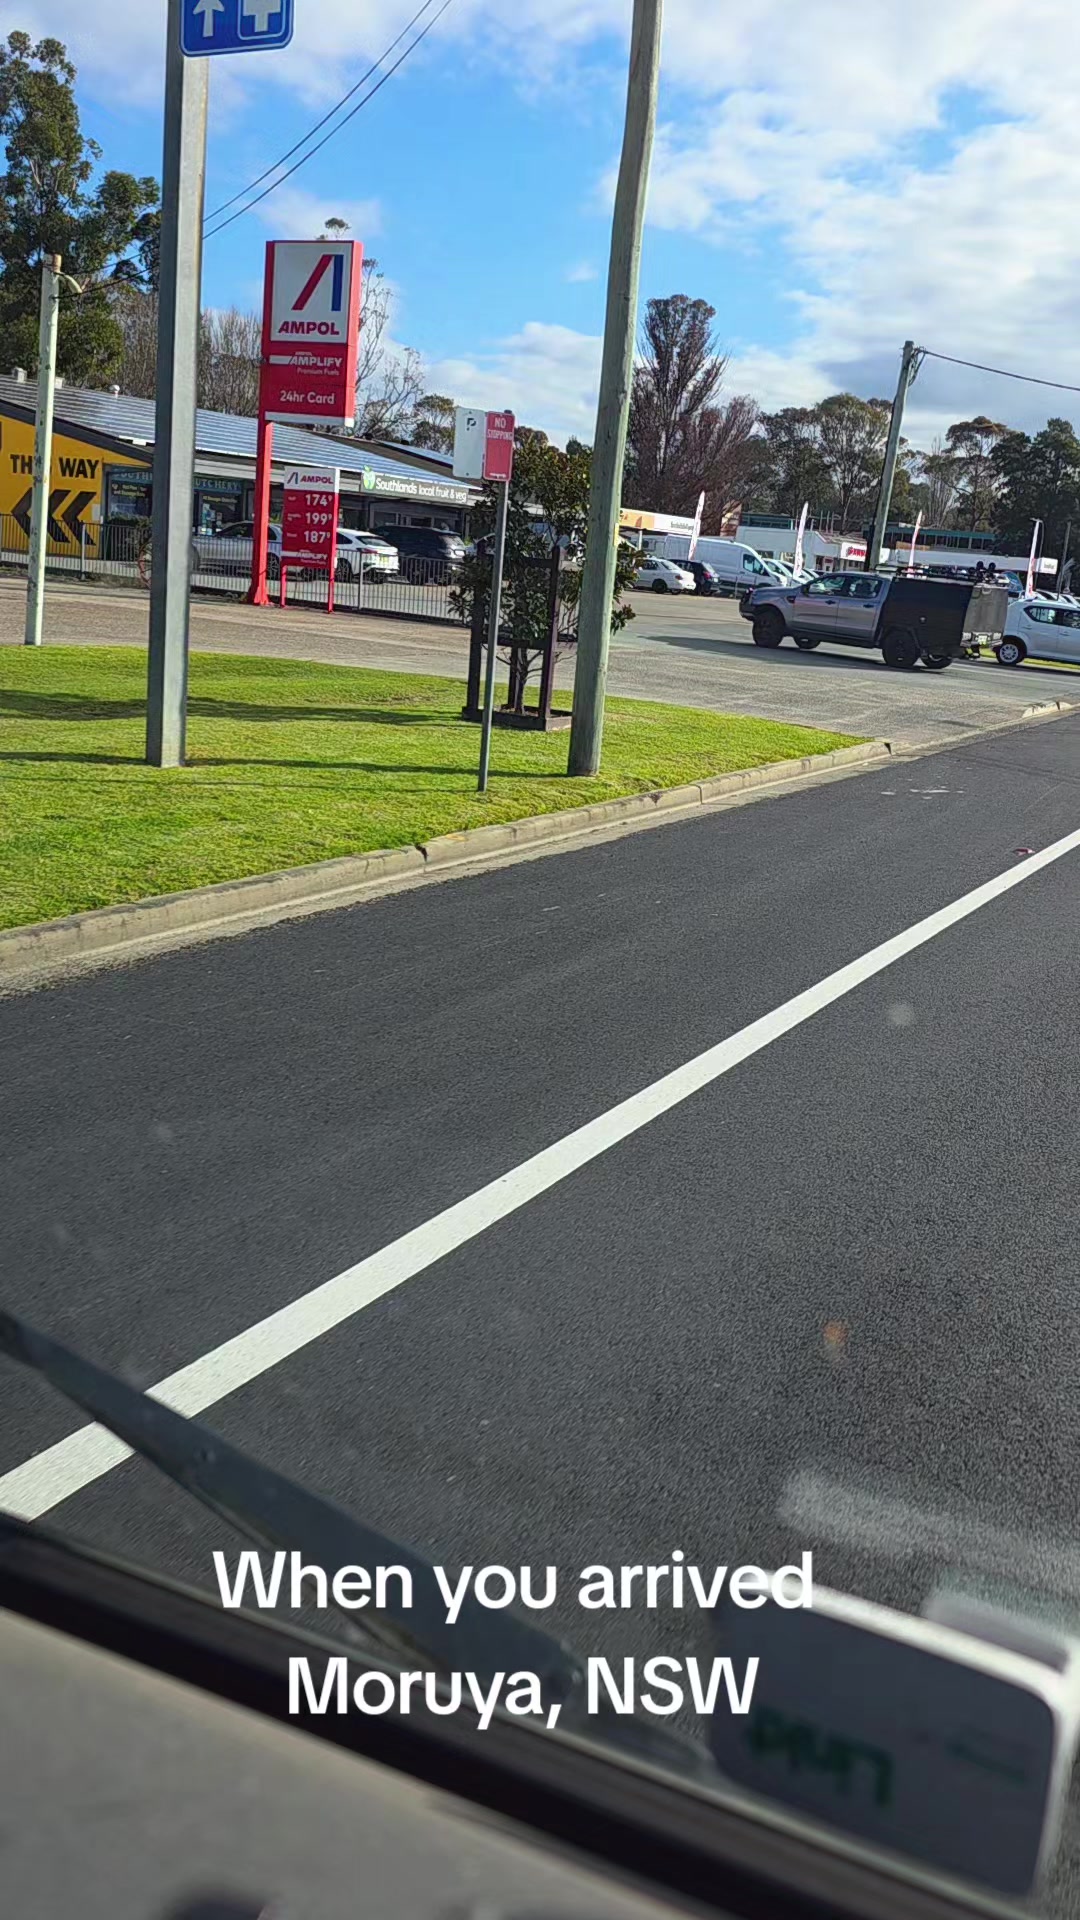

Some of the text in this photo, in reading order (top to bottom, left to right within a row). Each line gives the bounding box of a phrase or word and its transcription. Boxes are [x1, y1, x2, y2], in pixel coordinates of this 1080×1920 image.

[278, 321, 340, 336] AMPOL
[290, 356, 343, 367] AMPLIFY
[297, 367, 340, 376] Premium Fuels
[280, 390, 335, 404] 24hr Card
[494, 417, 507, 428] NO
[9, 454, 99, 479] TH WAY
[193, 479, 239, 491] UTCHERY
[300, 475, 334, 485] AMPOL
[375, 478, 417, 495] Southlands
[418, 484, 436, 497] local
[435, 486, 449, 498] fruit
[455, 491, 467, 503] veg
